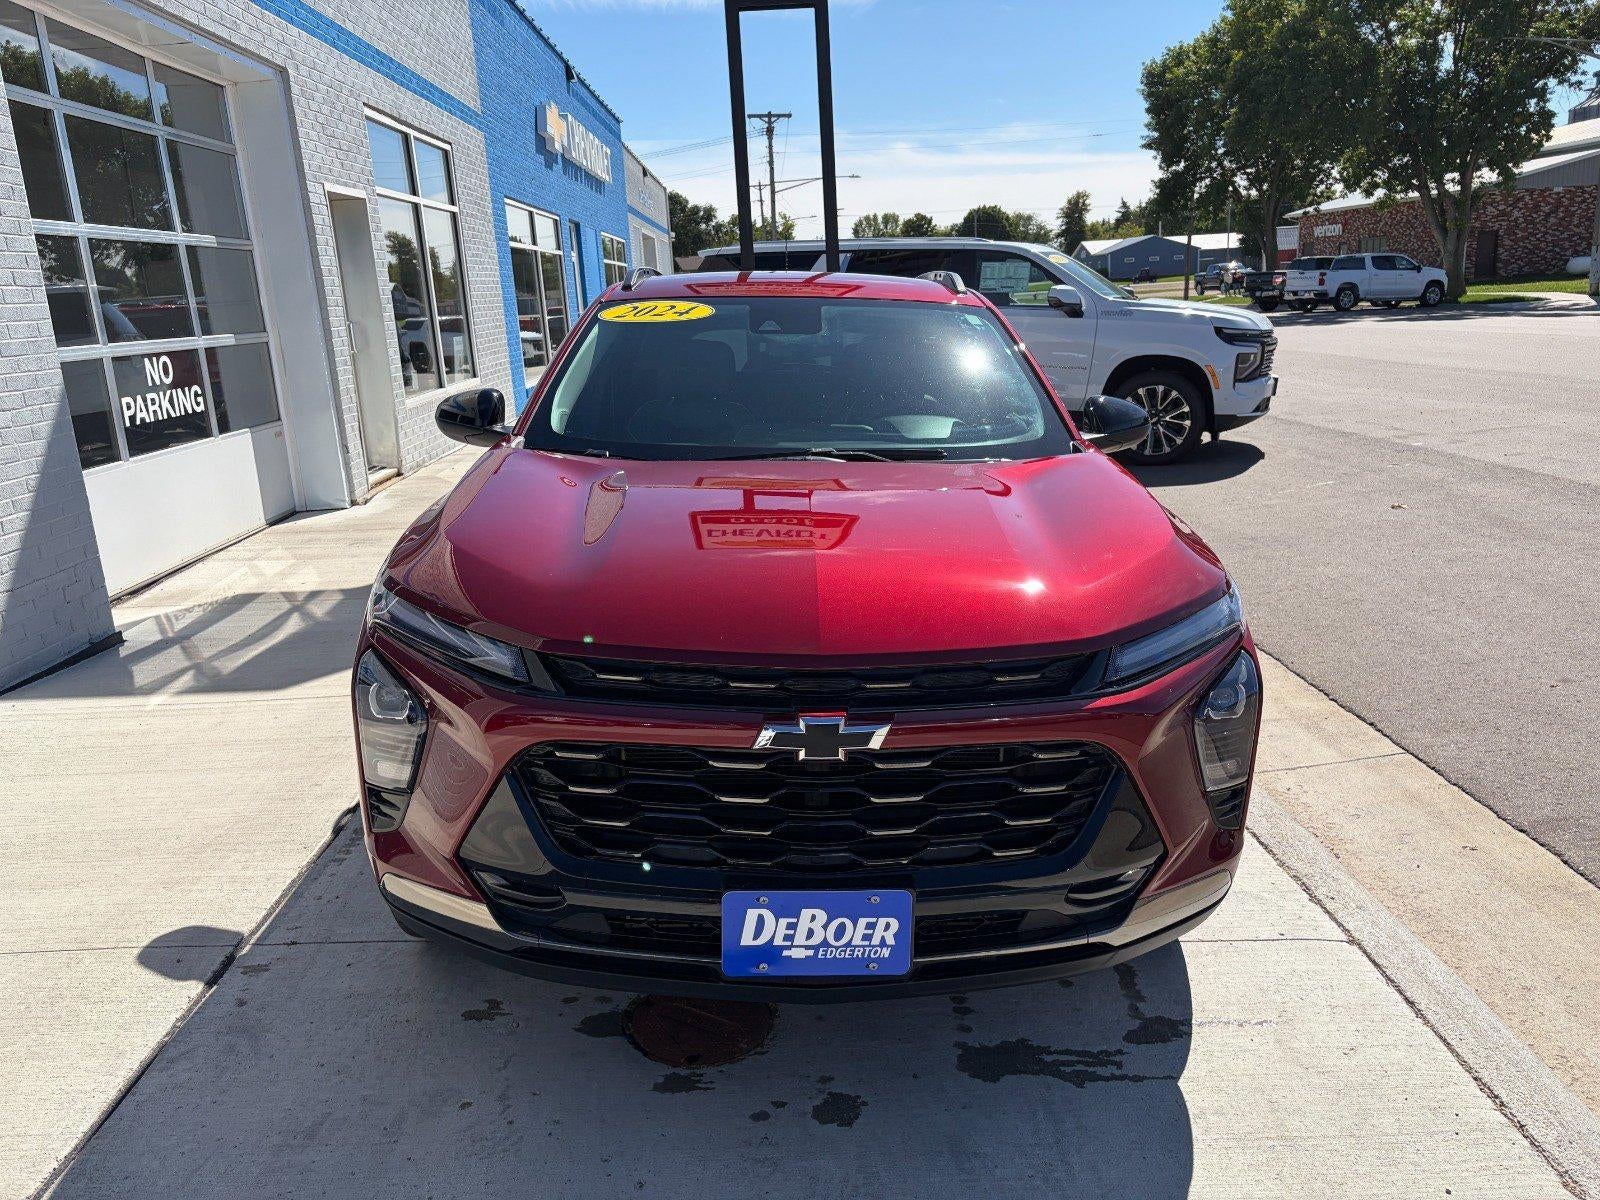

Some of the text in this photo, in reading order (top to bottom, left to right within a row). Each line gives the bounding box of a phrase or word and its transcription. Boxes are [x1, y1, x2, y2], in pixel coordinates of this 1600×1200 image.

[1314, 221, 1343, 238] verizon
[611, 304, 701, 319] 2024
[144, 355, 173, 387] NO
[121, 384, 205, 427] PARKING
[818, 947, 891, 959] EDGERTON
